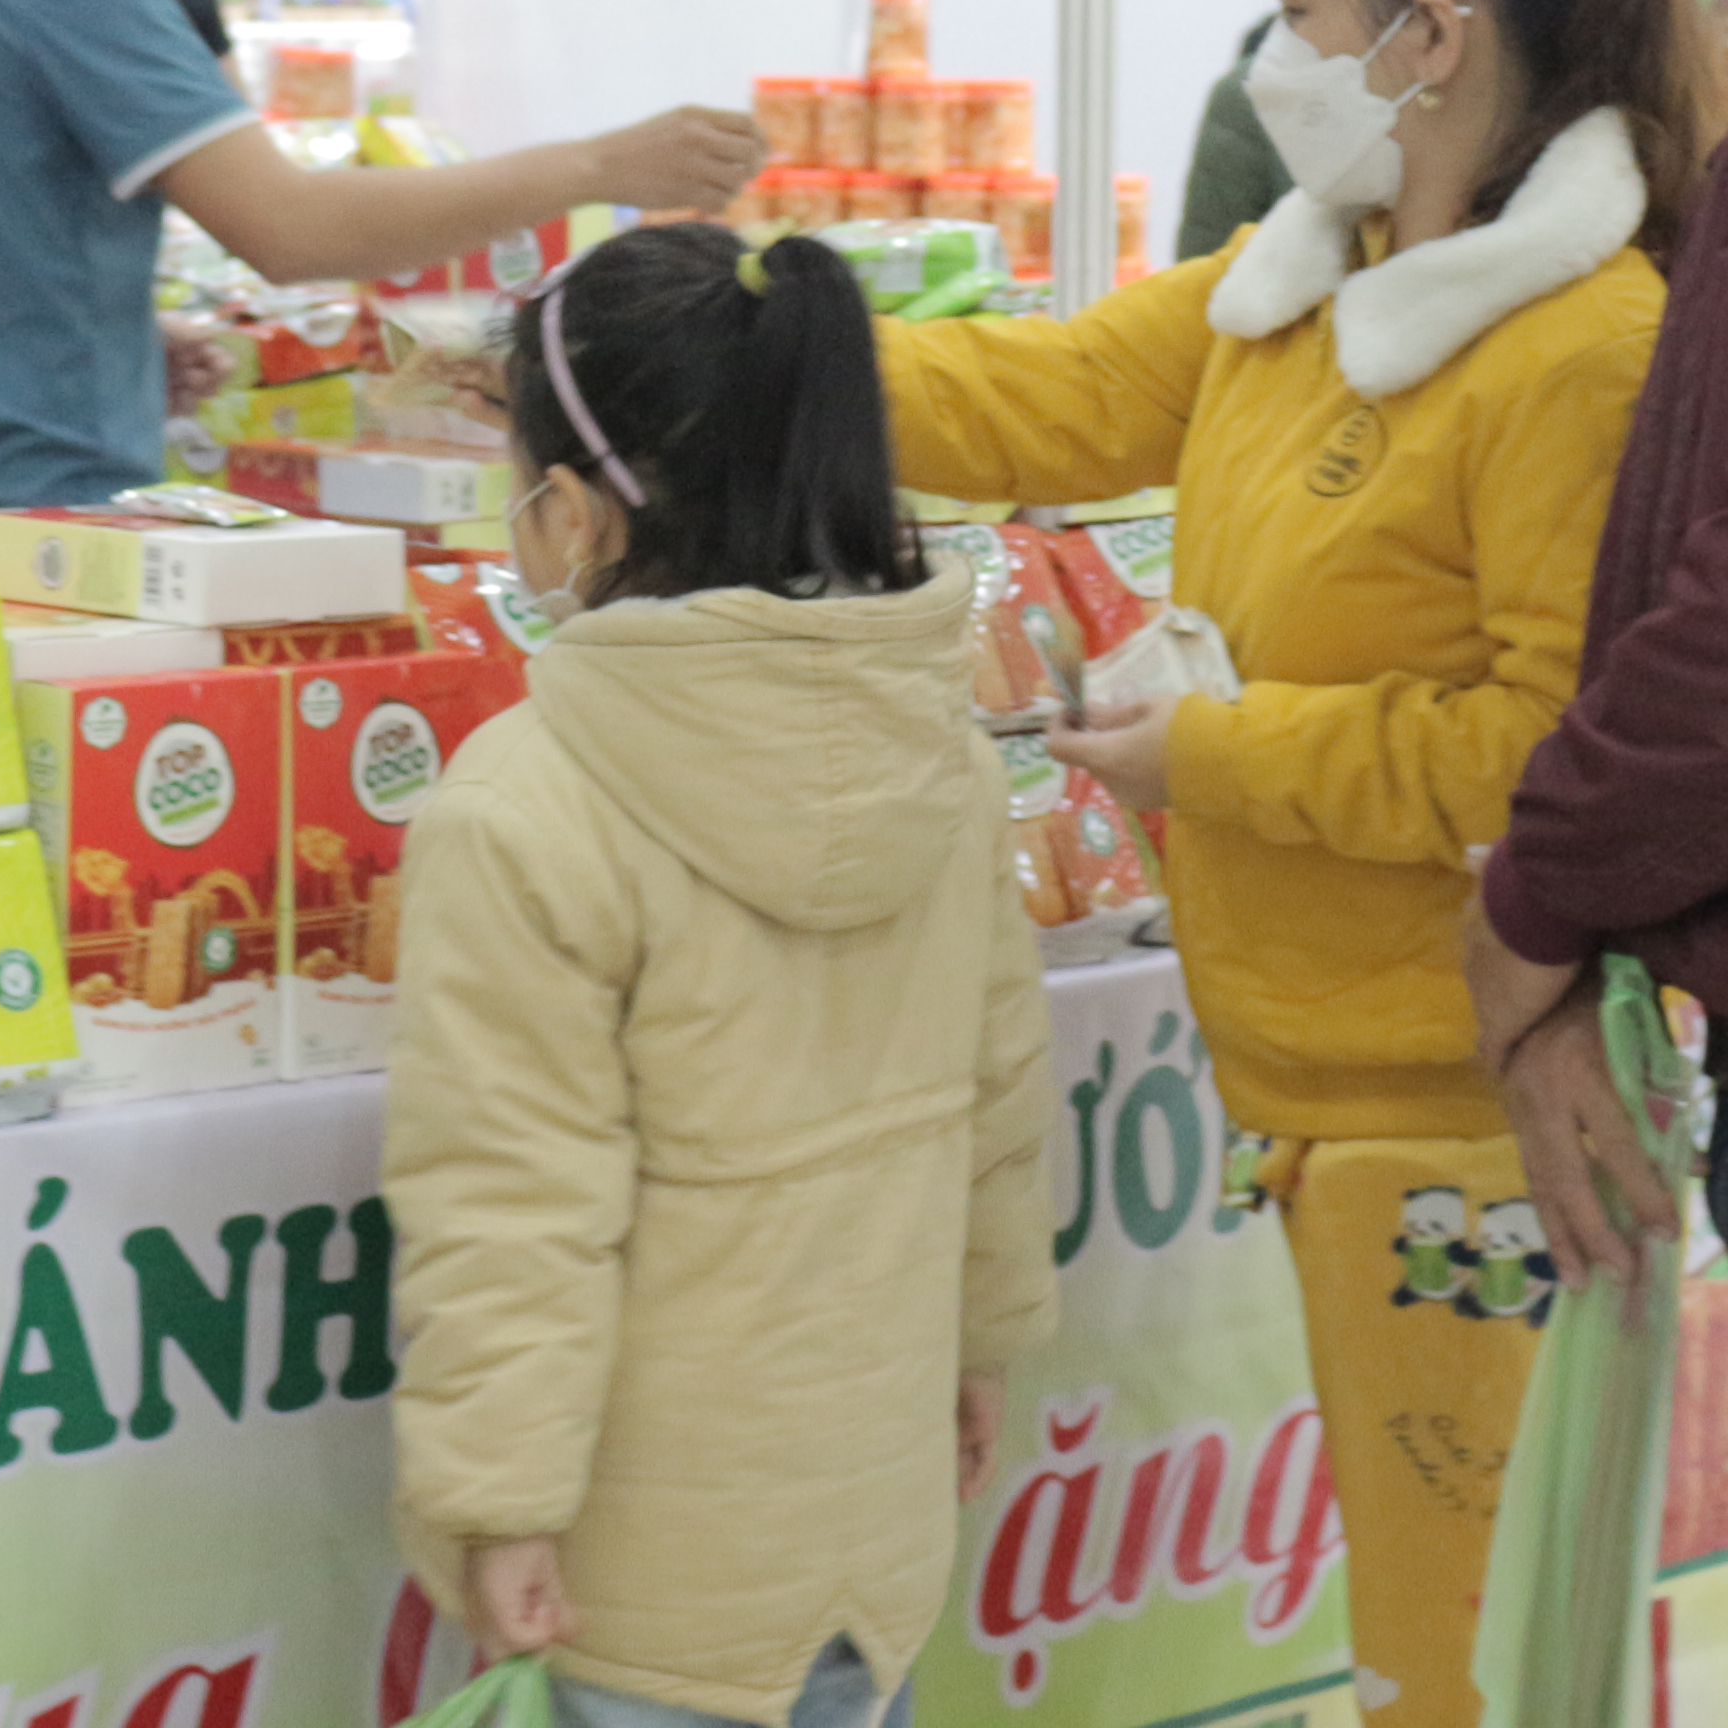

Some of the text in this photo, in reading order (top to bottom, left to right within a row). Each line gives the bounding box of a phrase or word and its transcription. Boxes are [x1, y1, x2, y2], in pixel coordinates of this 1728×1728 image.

[149, 767, 222, 811] COCO
[363, 745, 430, 789] COCO
[978, 1392, 1348, 1695] ặng
